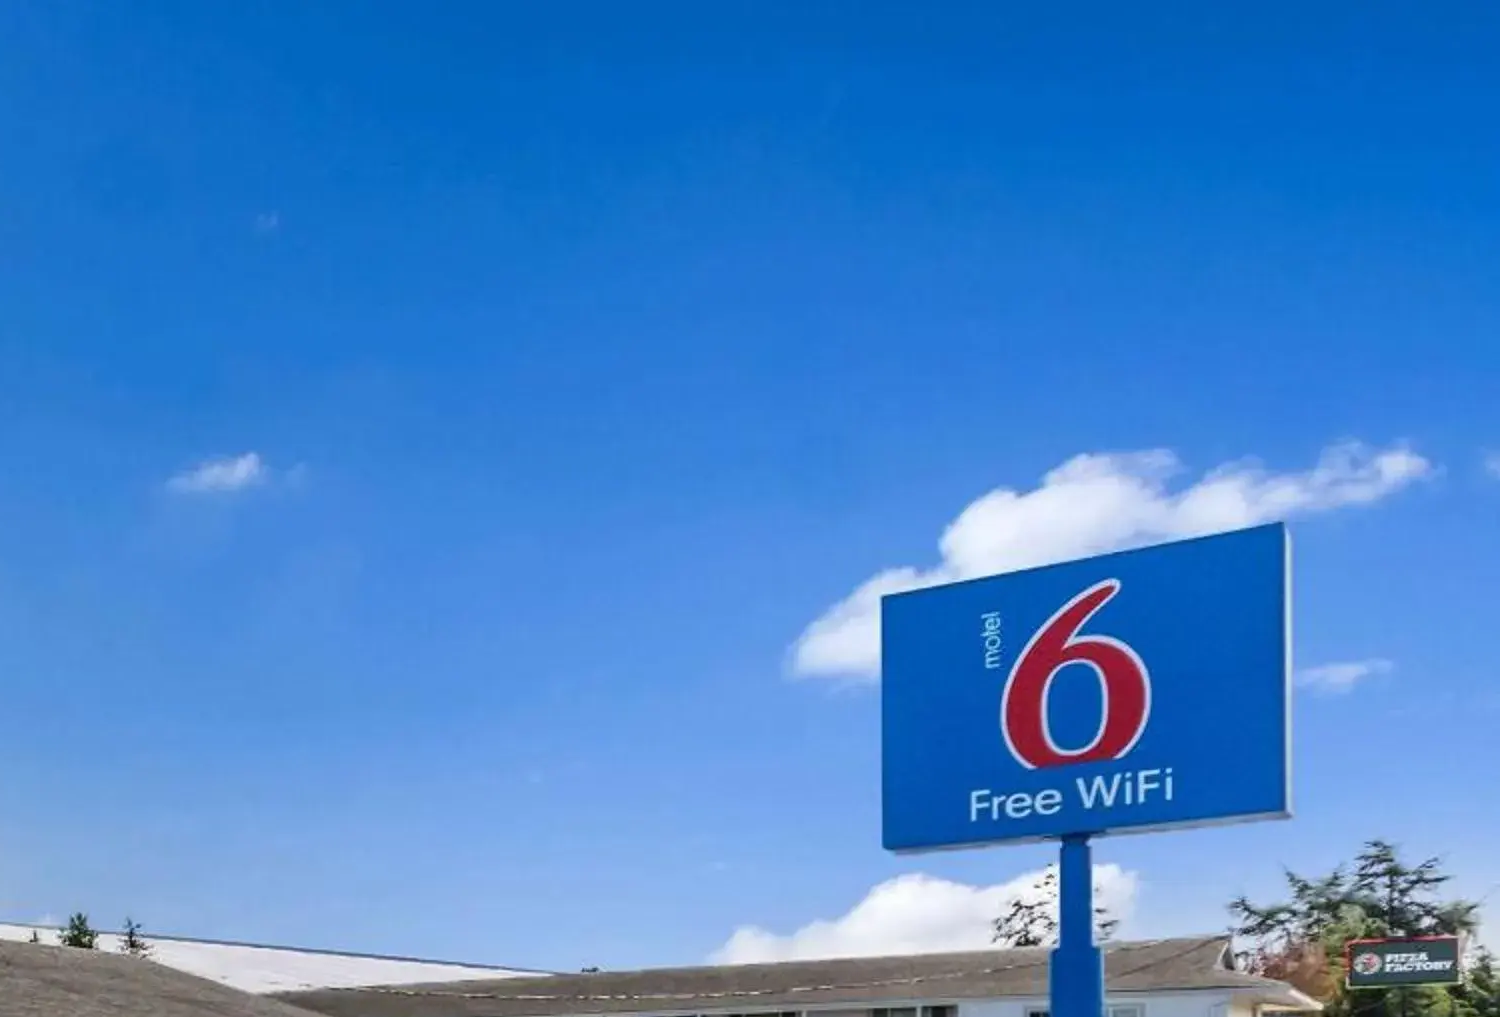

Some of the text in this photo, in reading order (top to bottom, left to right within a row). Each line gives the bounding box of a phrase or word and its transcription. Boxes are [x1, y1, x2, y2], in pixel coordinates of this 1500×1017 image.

[981, 611, 1000, 669] motel
[1001, 578, 1152, 769] 6
[970, 767, 1173, 822] Free WiFi
[1384, 961, 1452, 972] FACTORY
